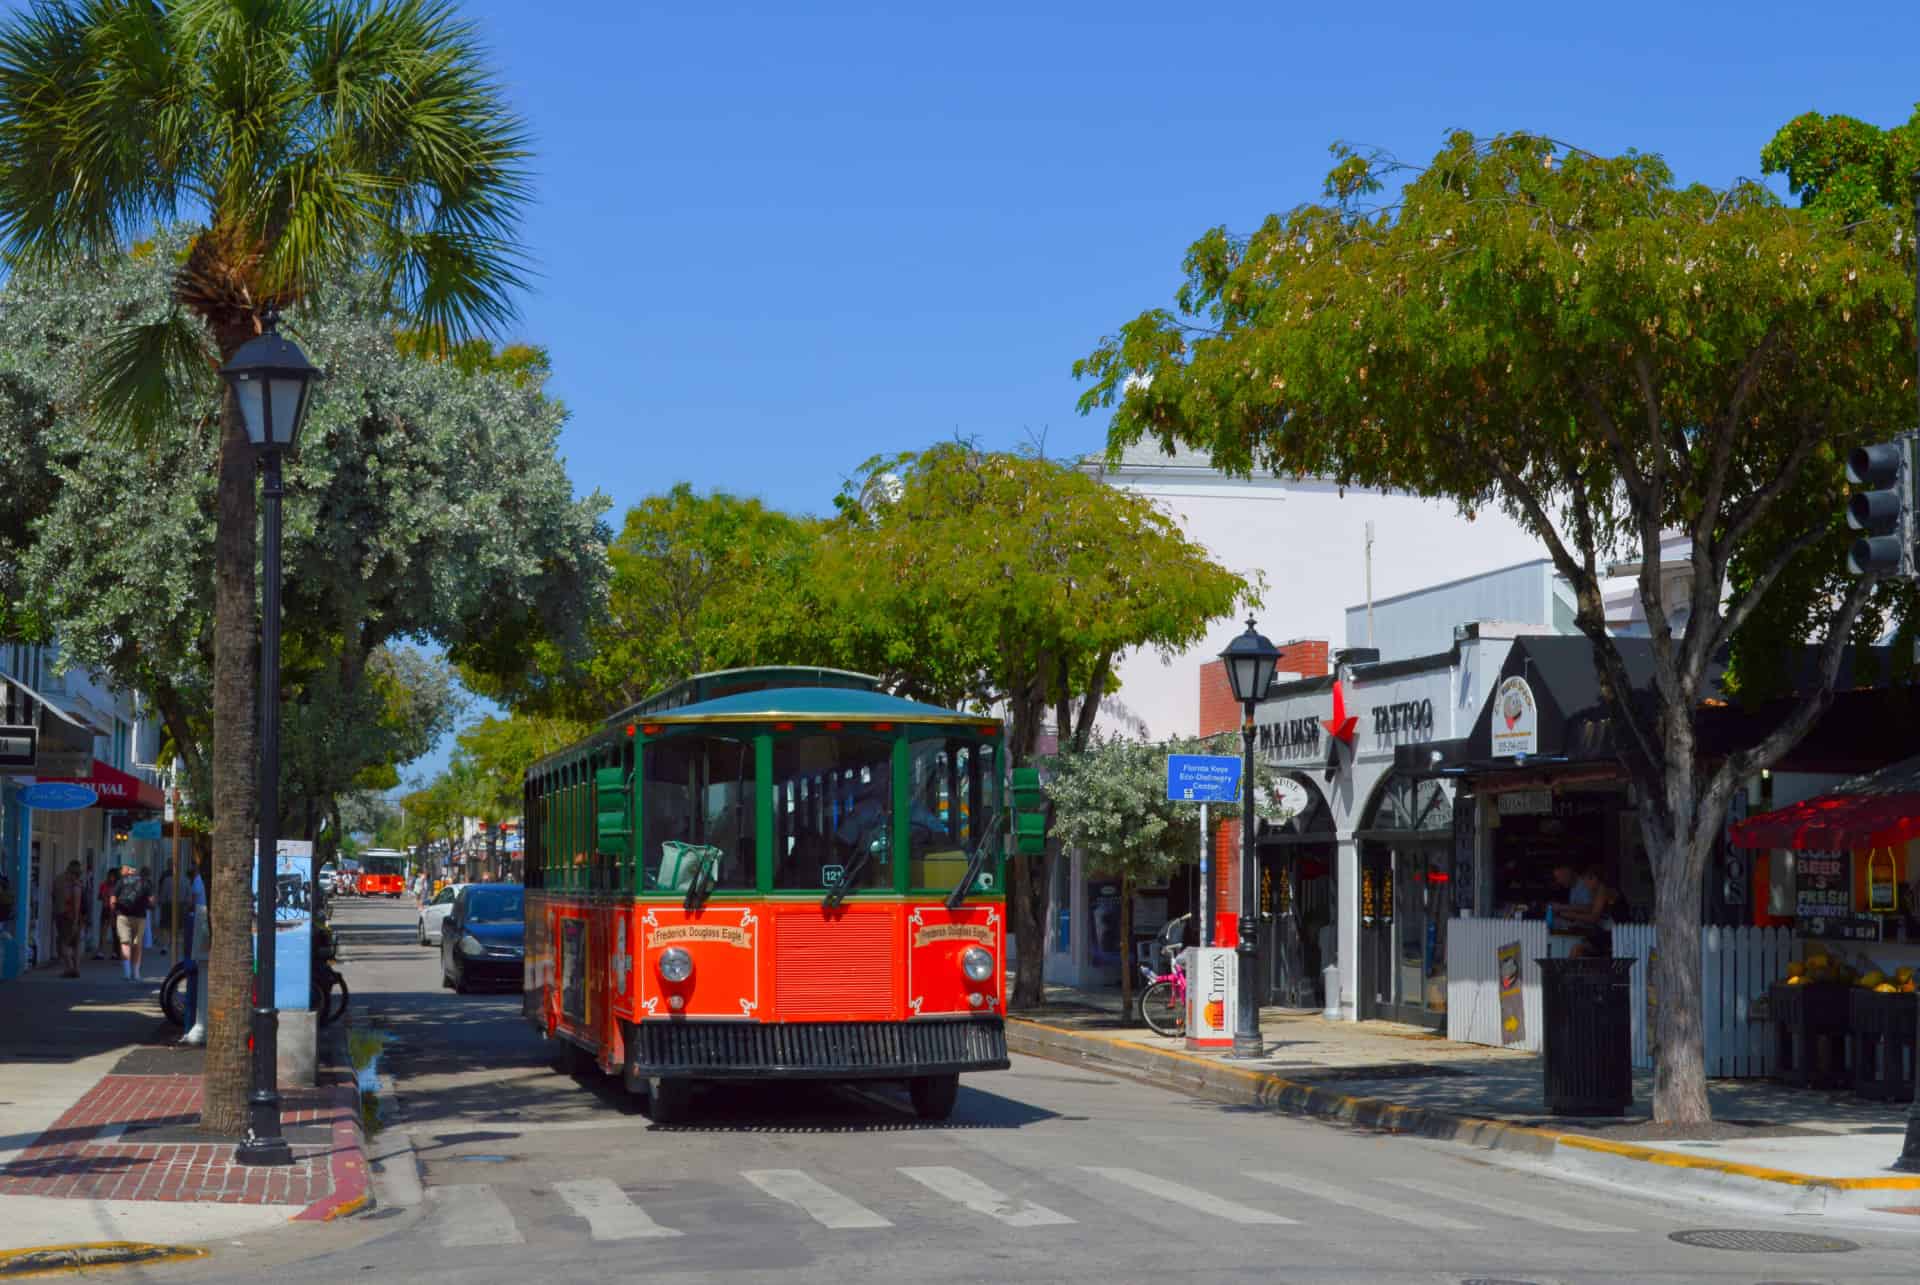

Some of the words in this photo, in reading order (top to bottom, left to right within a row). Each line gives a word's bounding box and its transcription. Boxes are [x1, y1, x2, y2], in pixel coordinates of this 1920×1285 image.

[1372, 698, 1433, 735] TATTOO
[1259, 716, 1320, 751] PARADISE
[1183, 763, 1208, 773] Florida
[1798, 860, 1841, 874] BEER
[1798, 890, 1849, 905] FRESH
[655, 928, 687, 941] Frederick
[689, 926, 720, 939] Douglass
[722, 928, 744, 943] Eagle
